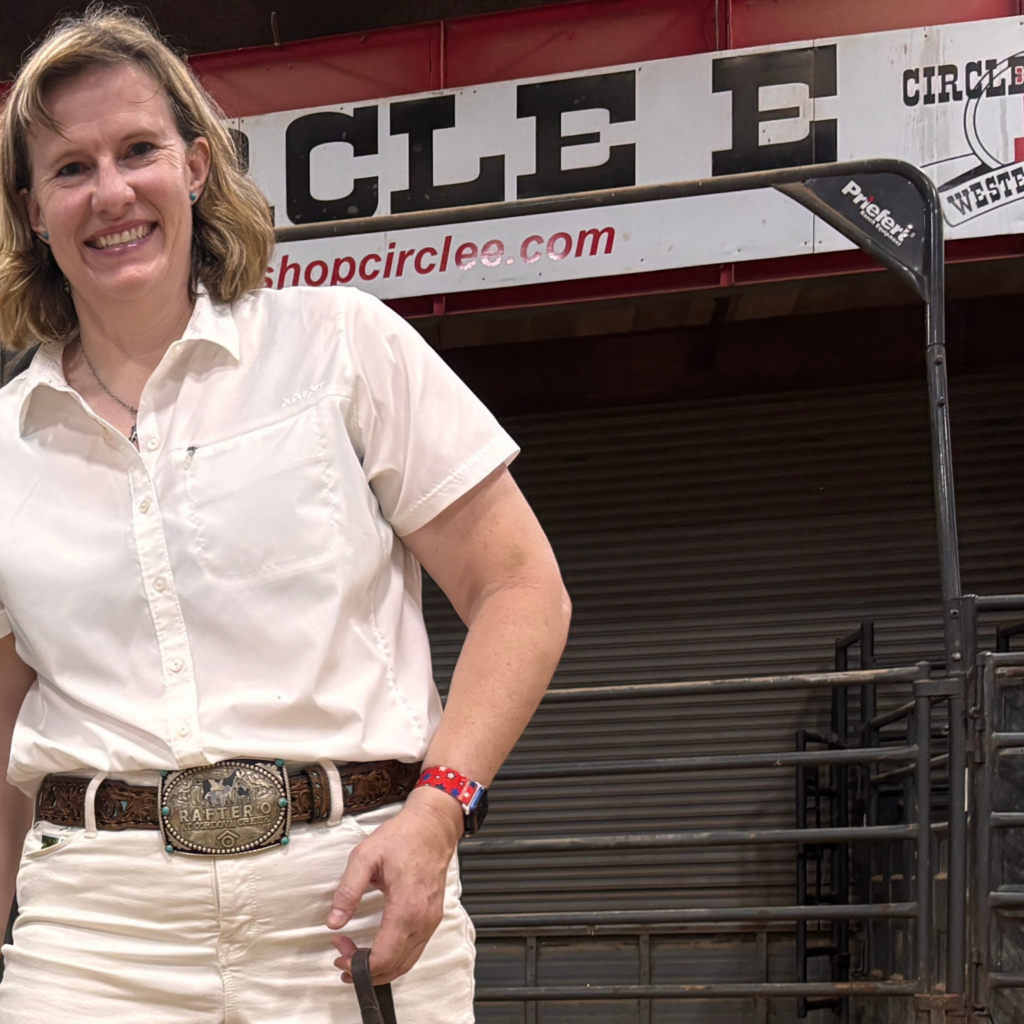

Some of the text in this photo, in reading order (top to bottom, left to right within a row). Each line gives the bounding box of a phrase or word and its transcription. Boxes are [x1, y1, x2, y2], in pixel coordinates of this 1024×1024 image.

[229, 43, 838, 225] CLE E
[179, 802, 272, 823] RAFTER O
